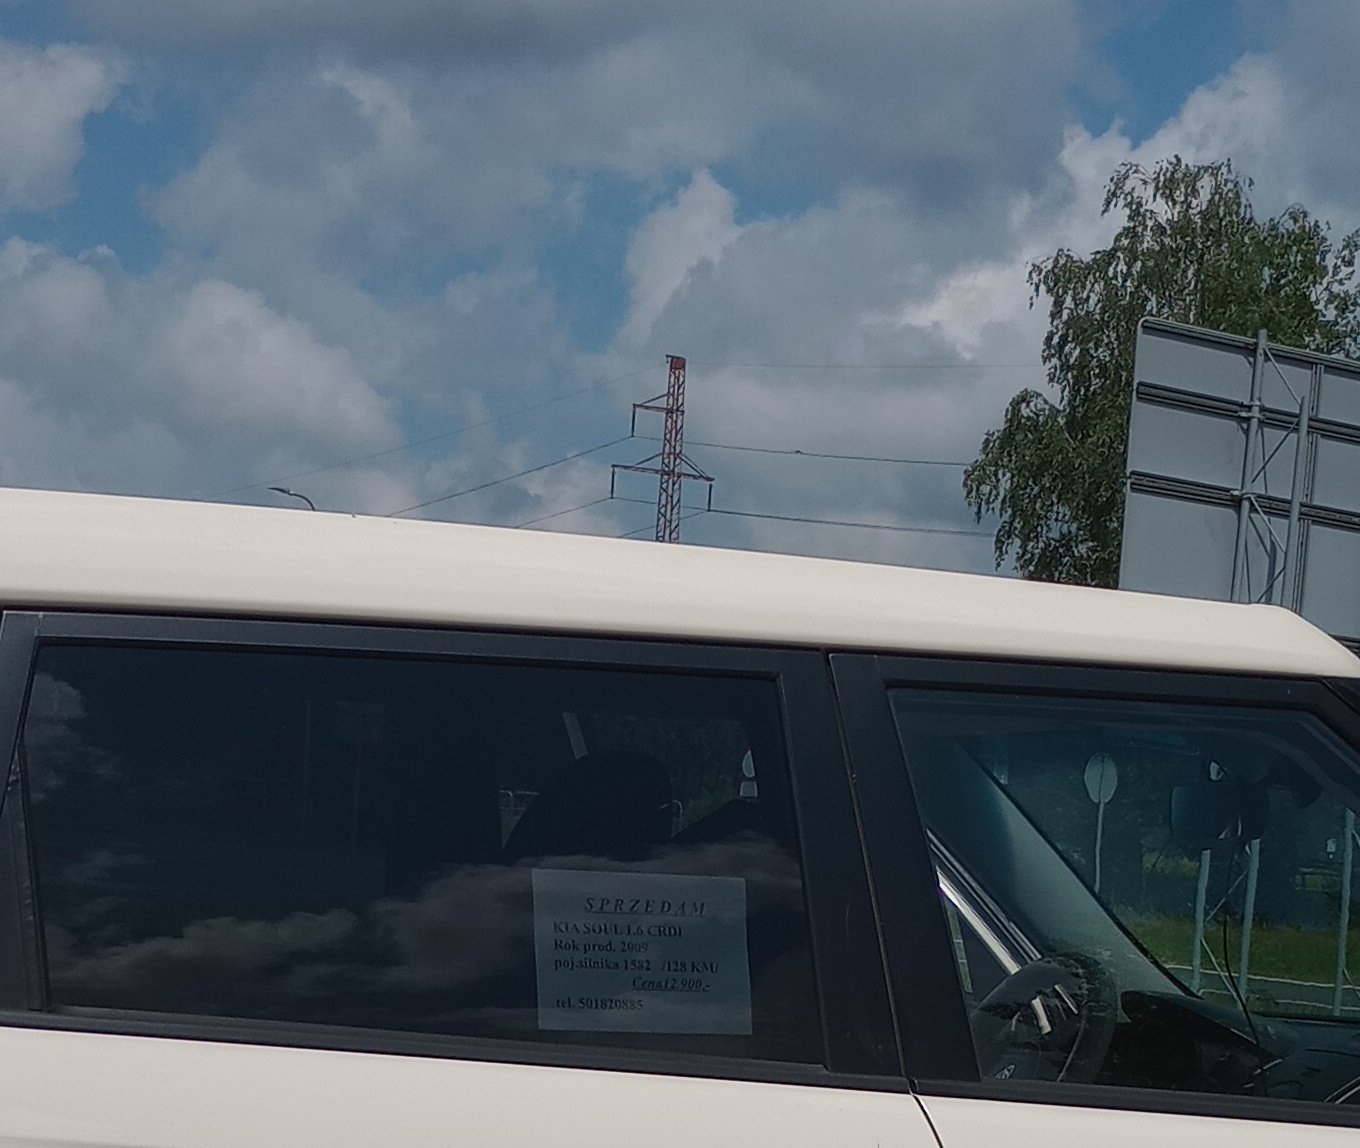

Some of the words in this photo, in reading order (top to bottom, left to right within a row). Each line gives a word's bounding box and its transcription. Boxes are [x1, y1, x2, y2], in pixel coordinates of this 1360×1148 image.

[553, 921, 579, 934] KIA
[583, 922, 623, 936] SOUL
[627, 924, 644, 936] 1.6
[647, 925, 683, 937] CRDI
[553, 939, 580, 952] Rok
[583, 940, 617, 954] prod.
[620, 941, 649, 953] 2009
[623, 959, 651, 972] 1582
[556, 997, 576, 1009] tel.
